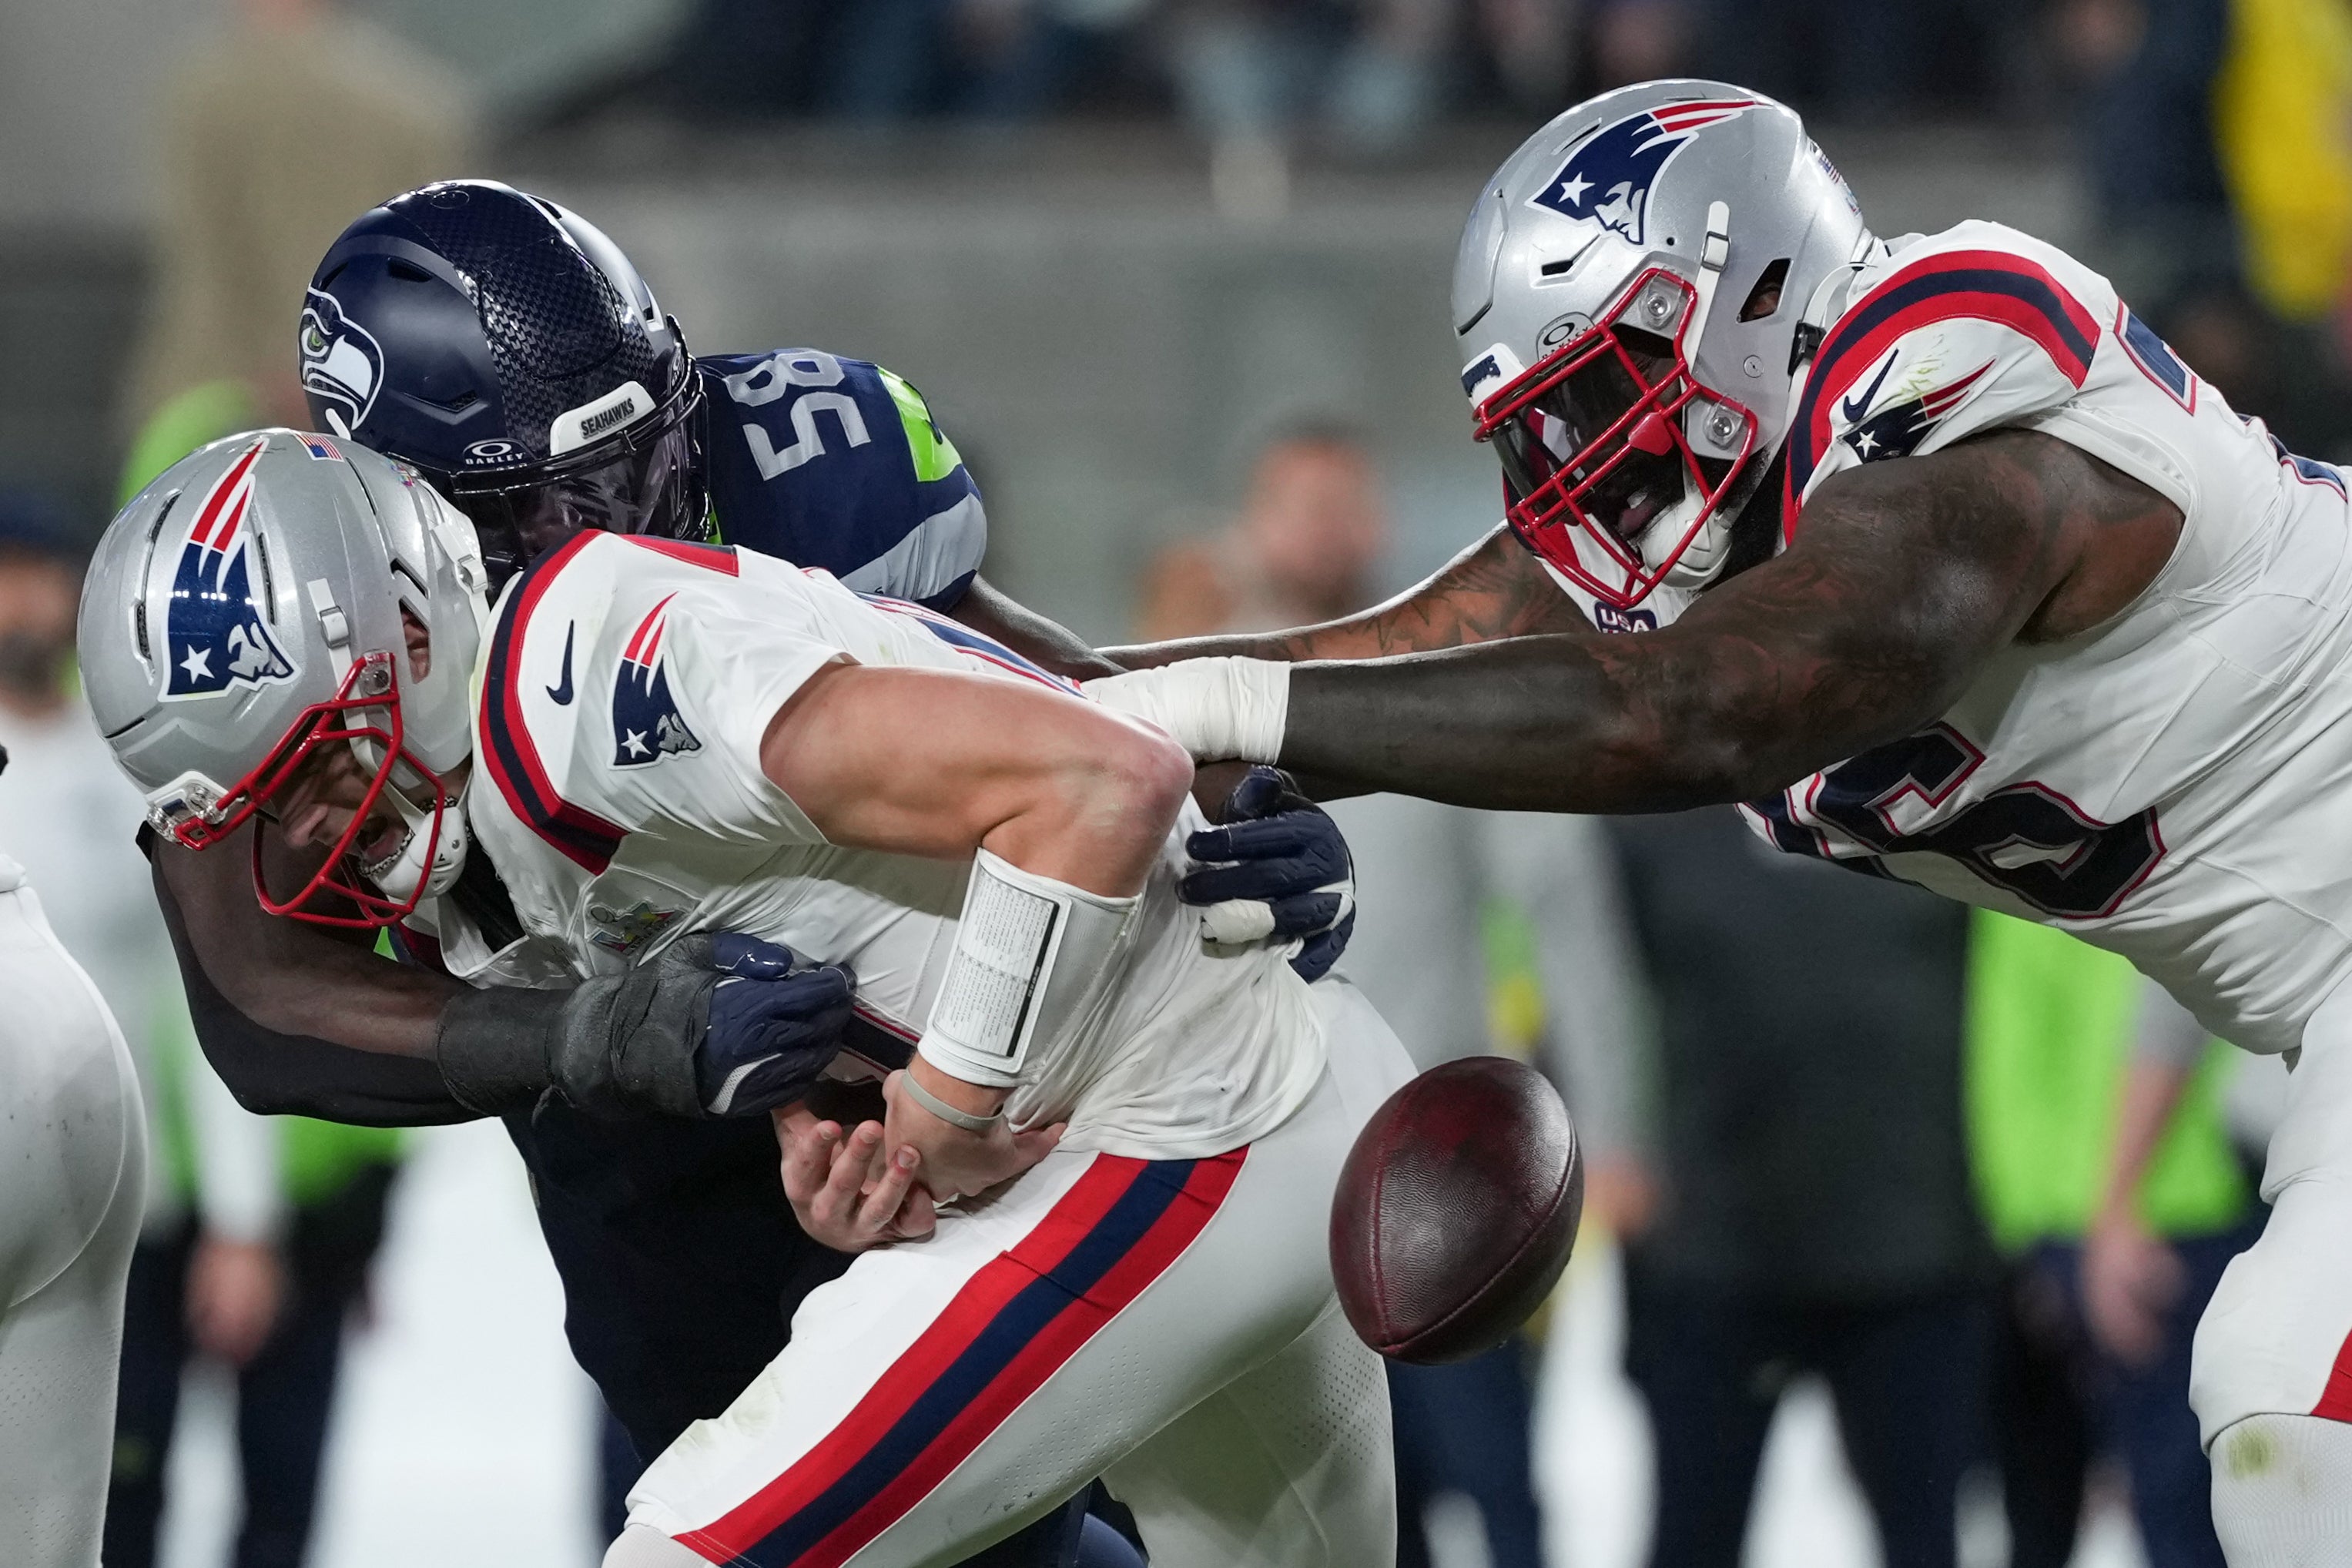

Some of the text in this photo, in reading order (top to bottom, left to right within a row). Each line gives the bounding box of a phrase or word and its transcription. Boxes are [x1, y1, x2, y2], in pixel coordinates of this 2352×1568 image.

[580, 397, 635, 438] SEAHAWKS
[722, 349, 871, 481] 58
[465, 452, 523, 465] OAKLEY
[1600, 608, 1650, 633] USA
